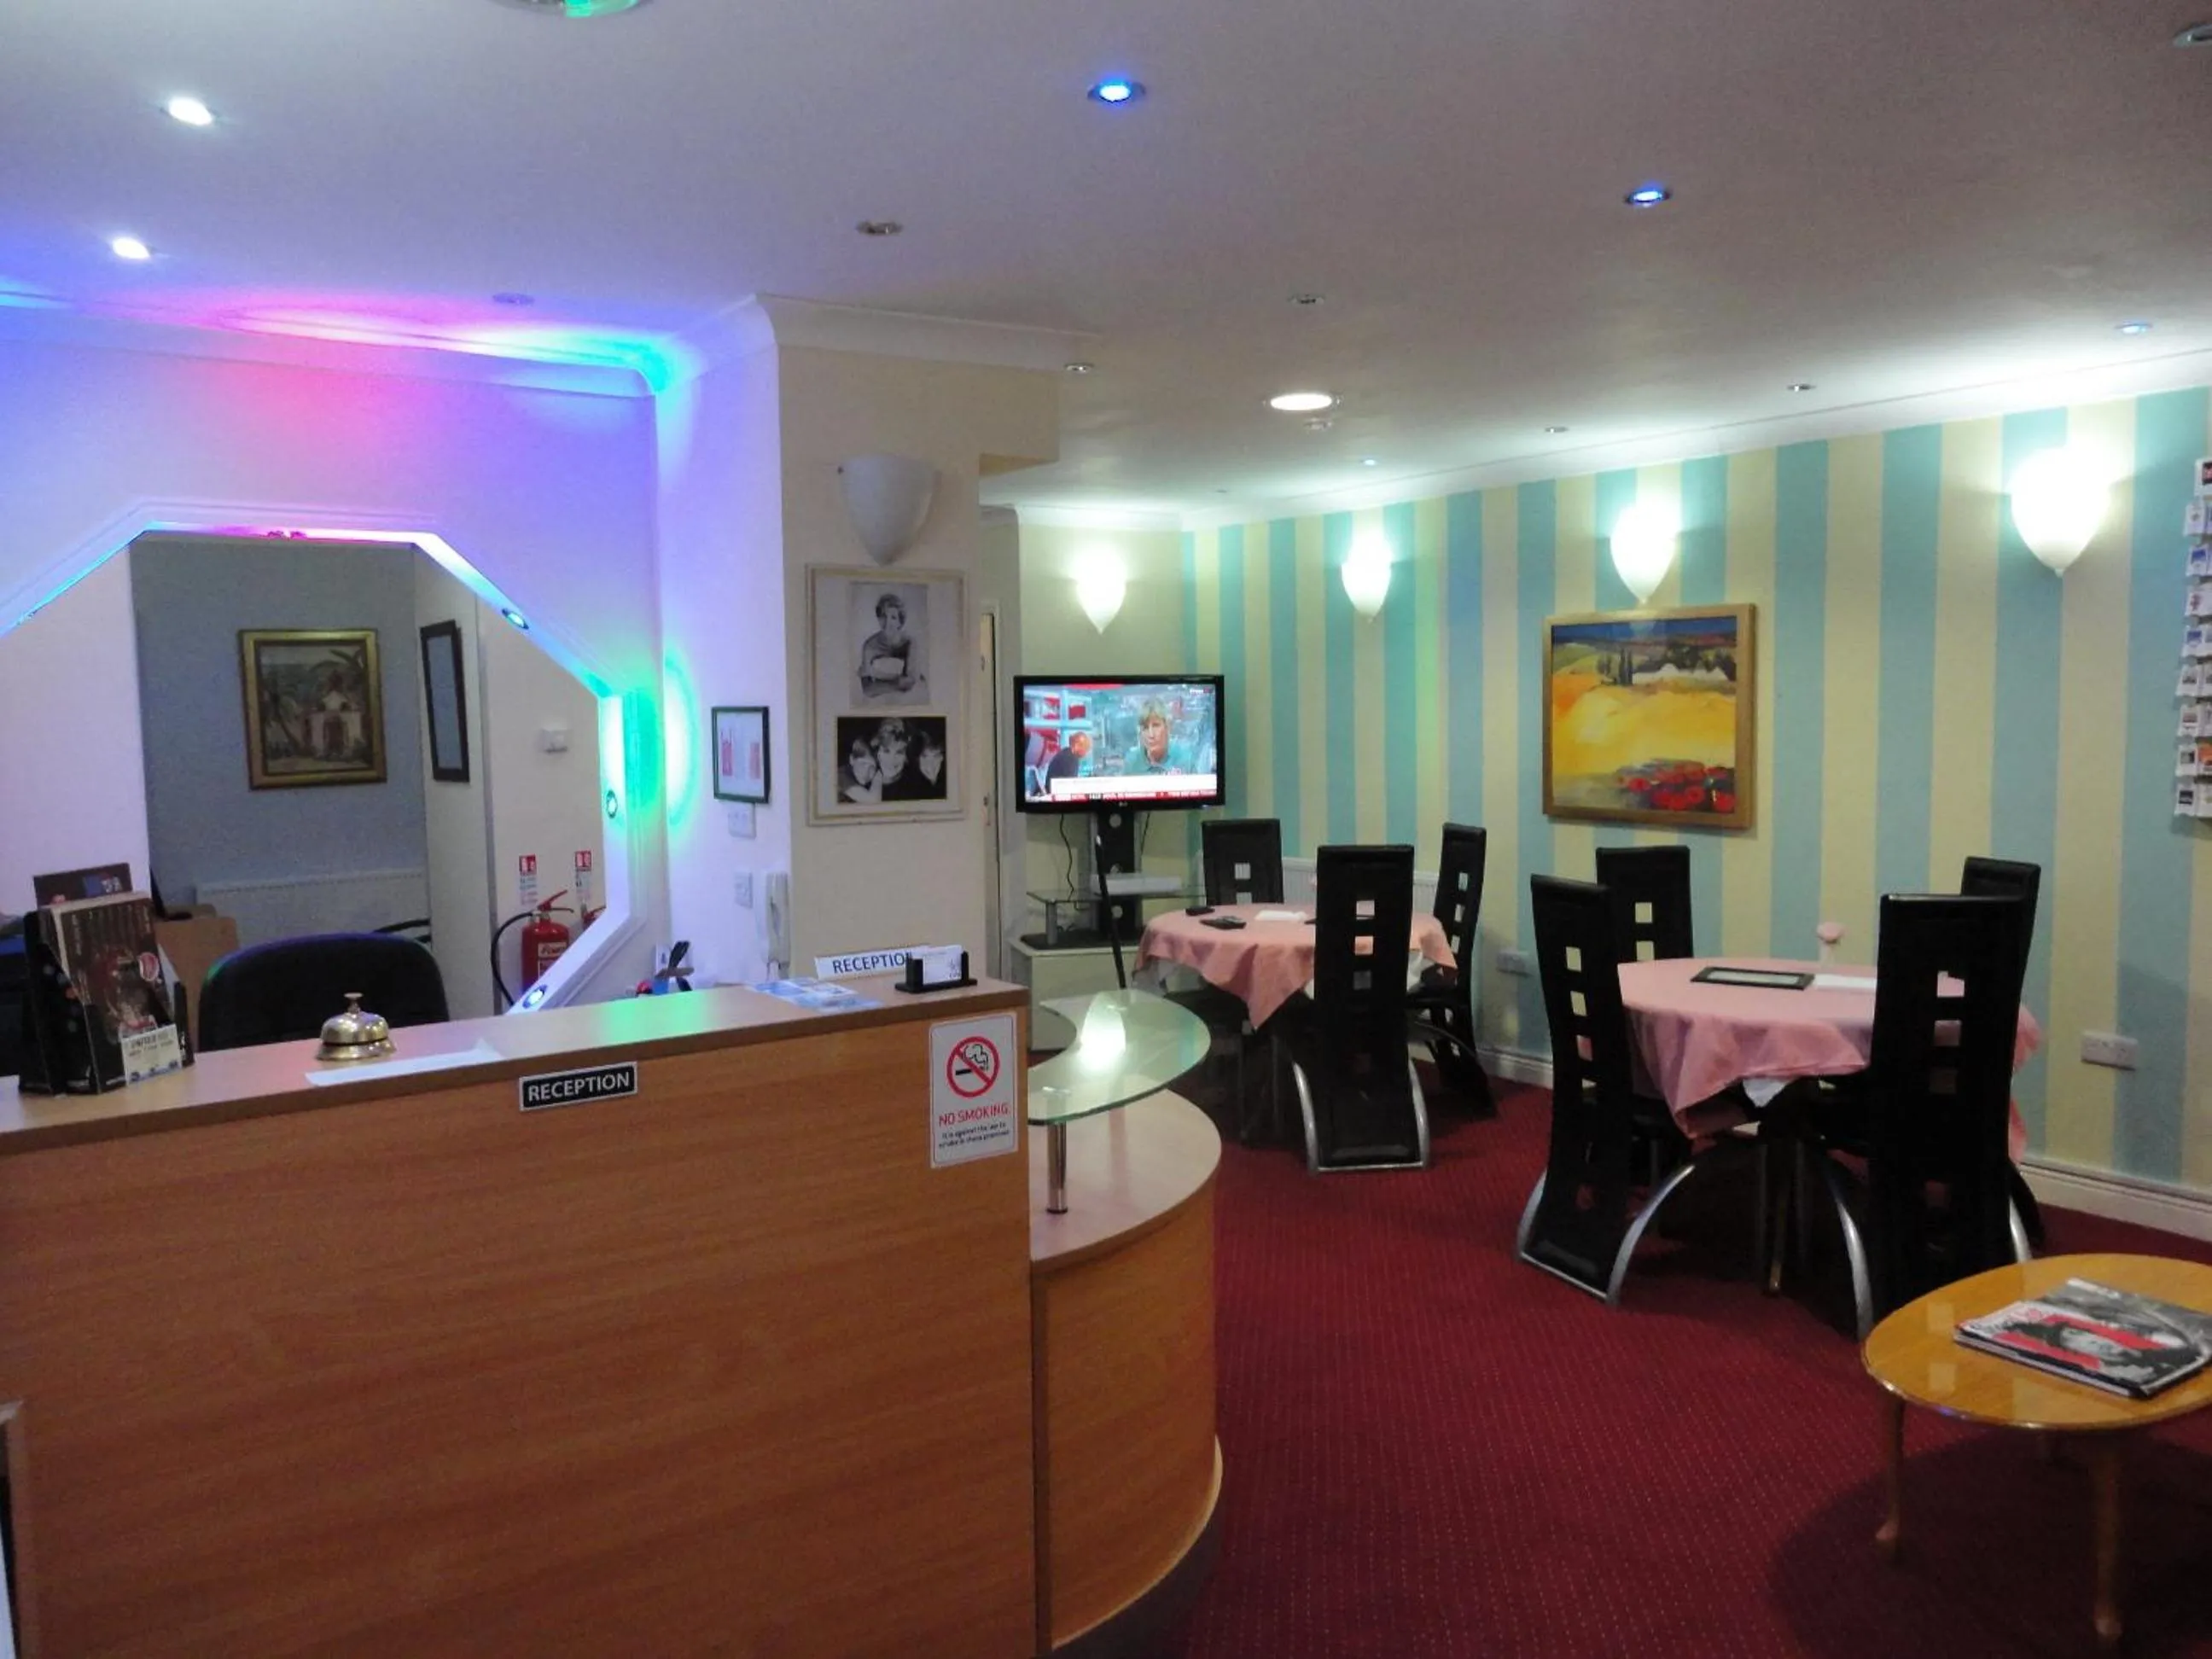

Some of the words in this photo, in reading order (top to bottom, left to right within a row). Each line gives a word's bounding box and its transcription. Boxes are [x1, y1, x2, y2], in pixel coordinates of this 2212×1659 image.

[527, 1072, 630, 1102] RECEPTION
[939, 1112, 955, 1127] NO
[958, 1103, 1010, 1123] SMOKING
